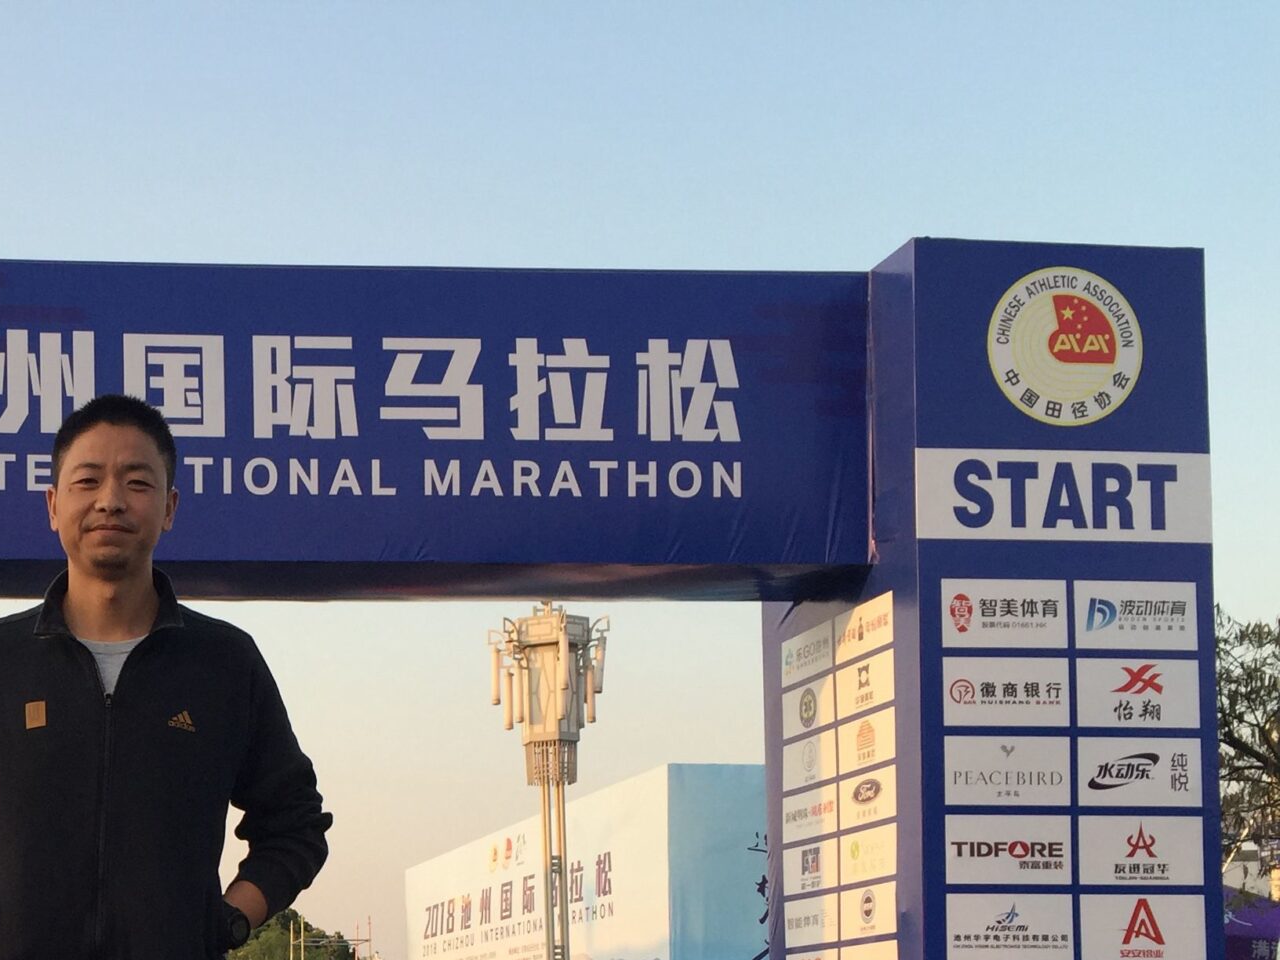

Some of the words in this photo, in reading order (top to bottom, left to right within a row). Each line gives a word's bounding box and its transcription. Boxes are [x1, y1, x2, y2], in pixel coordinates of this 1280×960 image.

[996, 295, 1025, 345] CHINESE
[1026, 275, 1078, 299] ATHLETIC
[1082, 280, 1134, 348] ASSOCIATION
[1004, 369, 1130, 419] 中国田径协会
[424, 459, 742, 498] MARATHON
[953, 459, 1178, 531] START
[979, 598, 1059, 618] 智美体育
[1119, 600, 1187, 616] 波动体育
[980, 682, 1062, 698] 徽商银行
[1113, 700, 1161, 722] 怡翔
[953, 770, 1063, 786] PEACEBIRD
[1096, 762, 1152, 780] 水动乐
[1171, 753, 1189, 792] 纯悦
[951, 841, 1064, 858] TIDFORE
[481, 918, 544, 943] INTERNATIONA
